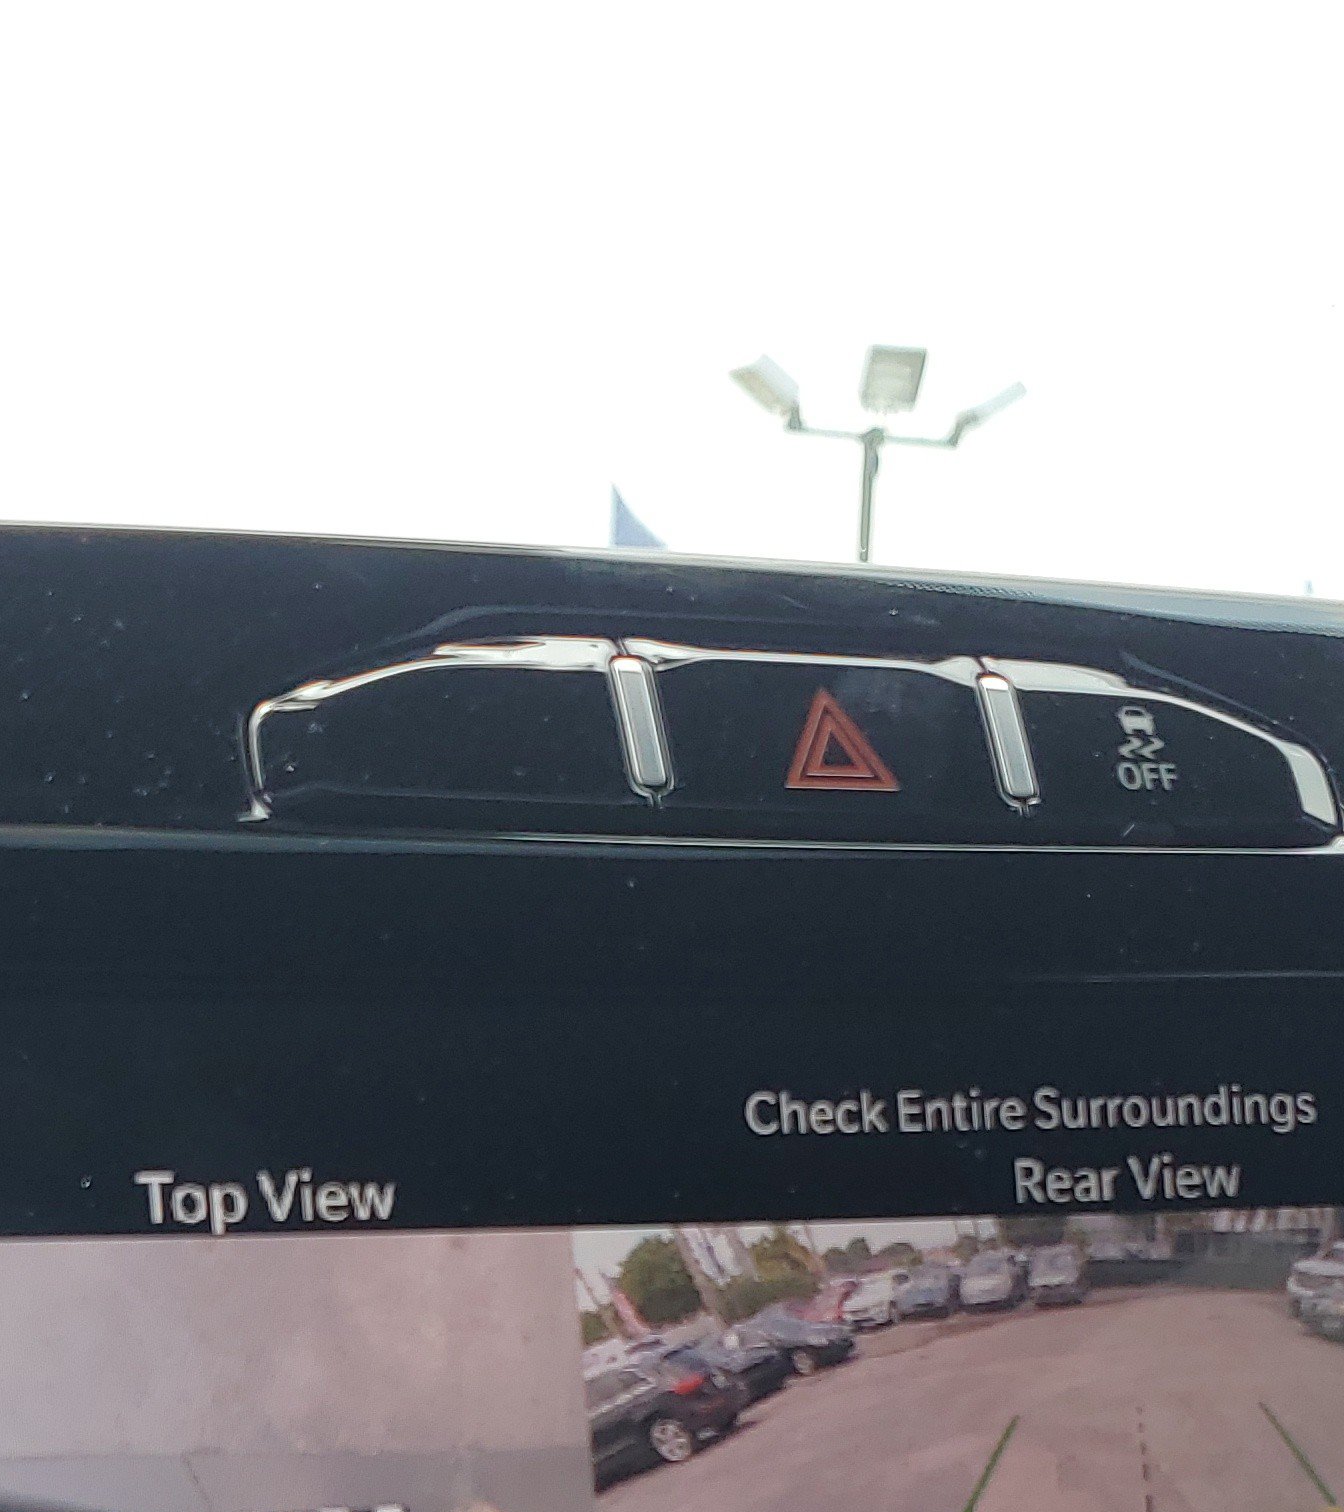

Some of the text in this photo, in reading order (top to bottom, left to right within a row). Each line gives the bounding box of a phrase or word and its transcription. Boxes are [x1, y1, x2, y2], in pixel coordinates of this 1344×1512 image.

[1117, 762, 1178, 792] OFF
[744, 1083, 1318, 1135] Check Entire Surroundings
[134, 1167, 397, 1236] Top View
[1013, 1151, 1242, 1204] Rear View
